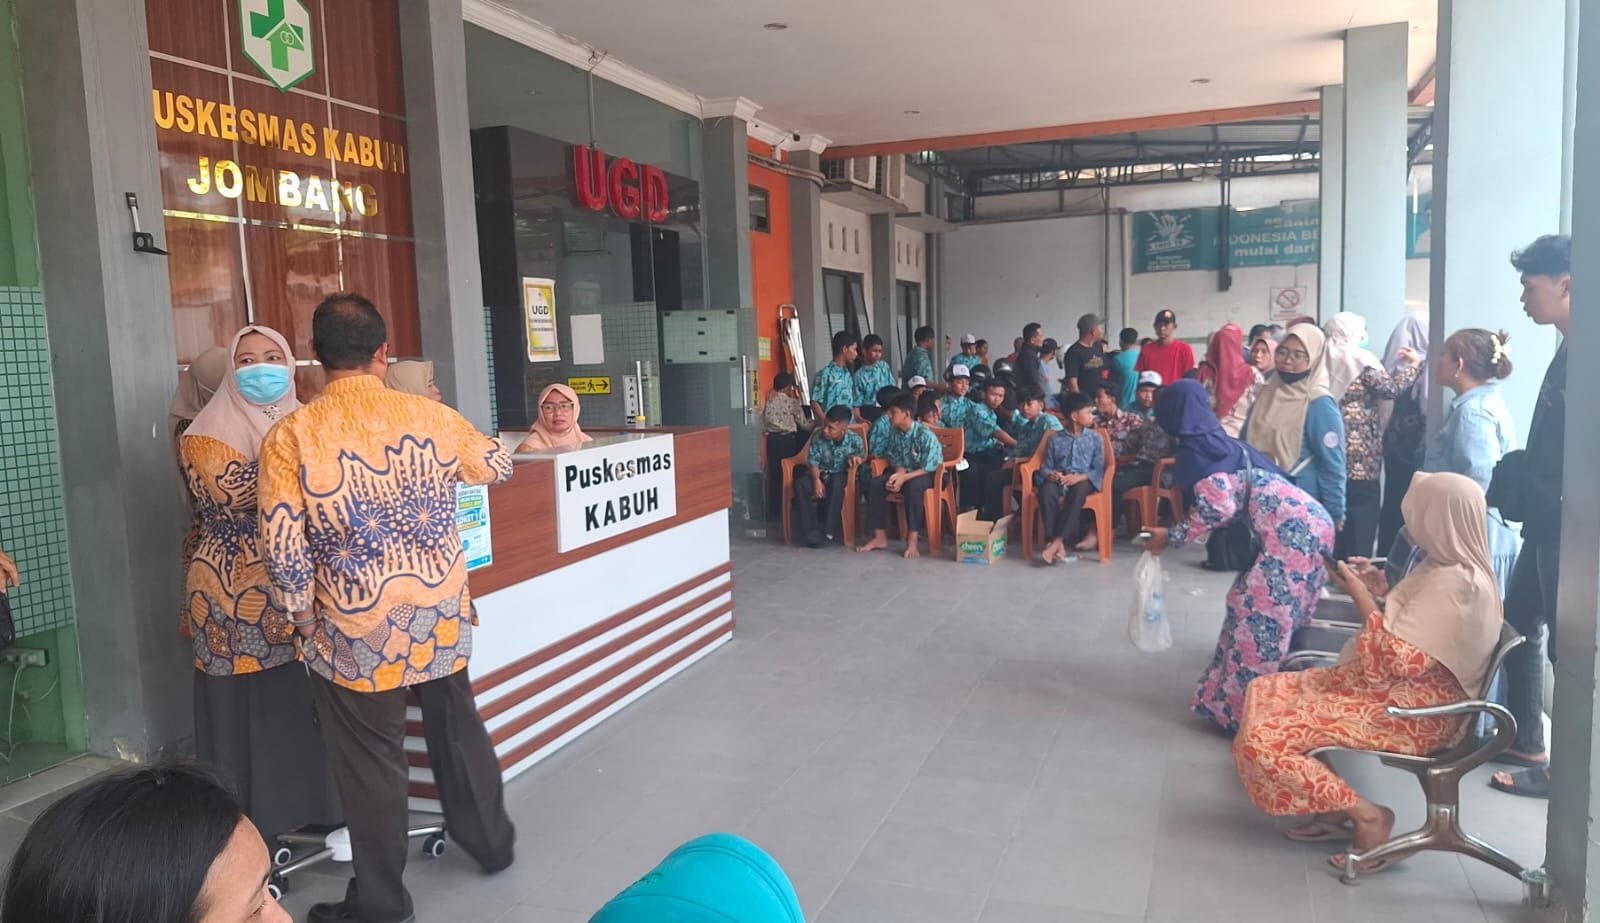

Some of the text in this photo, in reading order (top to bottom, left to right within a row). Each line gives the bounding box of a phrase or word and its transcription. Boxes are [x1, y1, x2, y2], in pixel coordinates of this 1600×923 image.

[152, 89, 405, 175] USKESMAS KABUH
[187, 155, 378, 217] JOMBANG
[573, 145, 669, 223] UGD
[1212, 230, 1298, 246] IDONESIA
[1234, 242, 1316, 257] mulai dari
[532, 305, 549, 316] UGD
[564, 452, 672, 492] Puskesmas
[584, 487, 659, 532] KABUH
